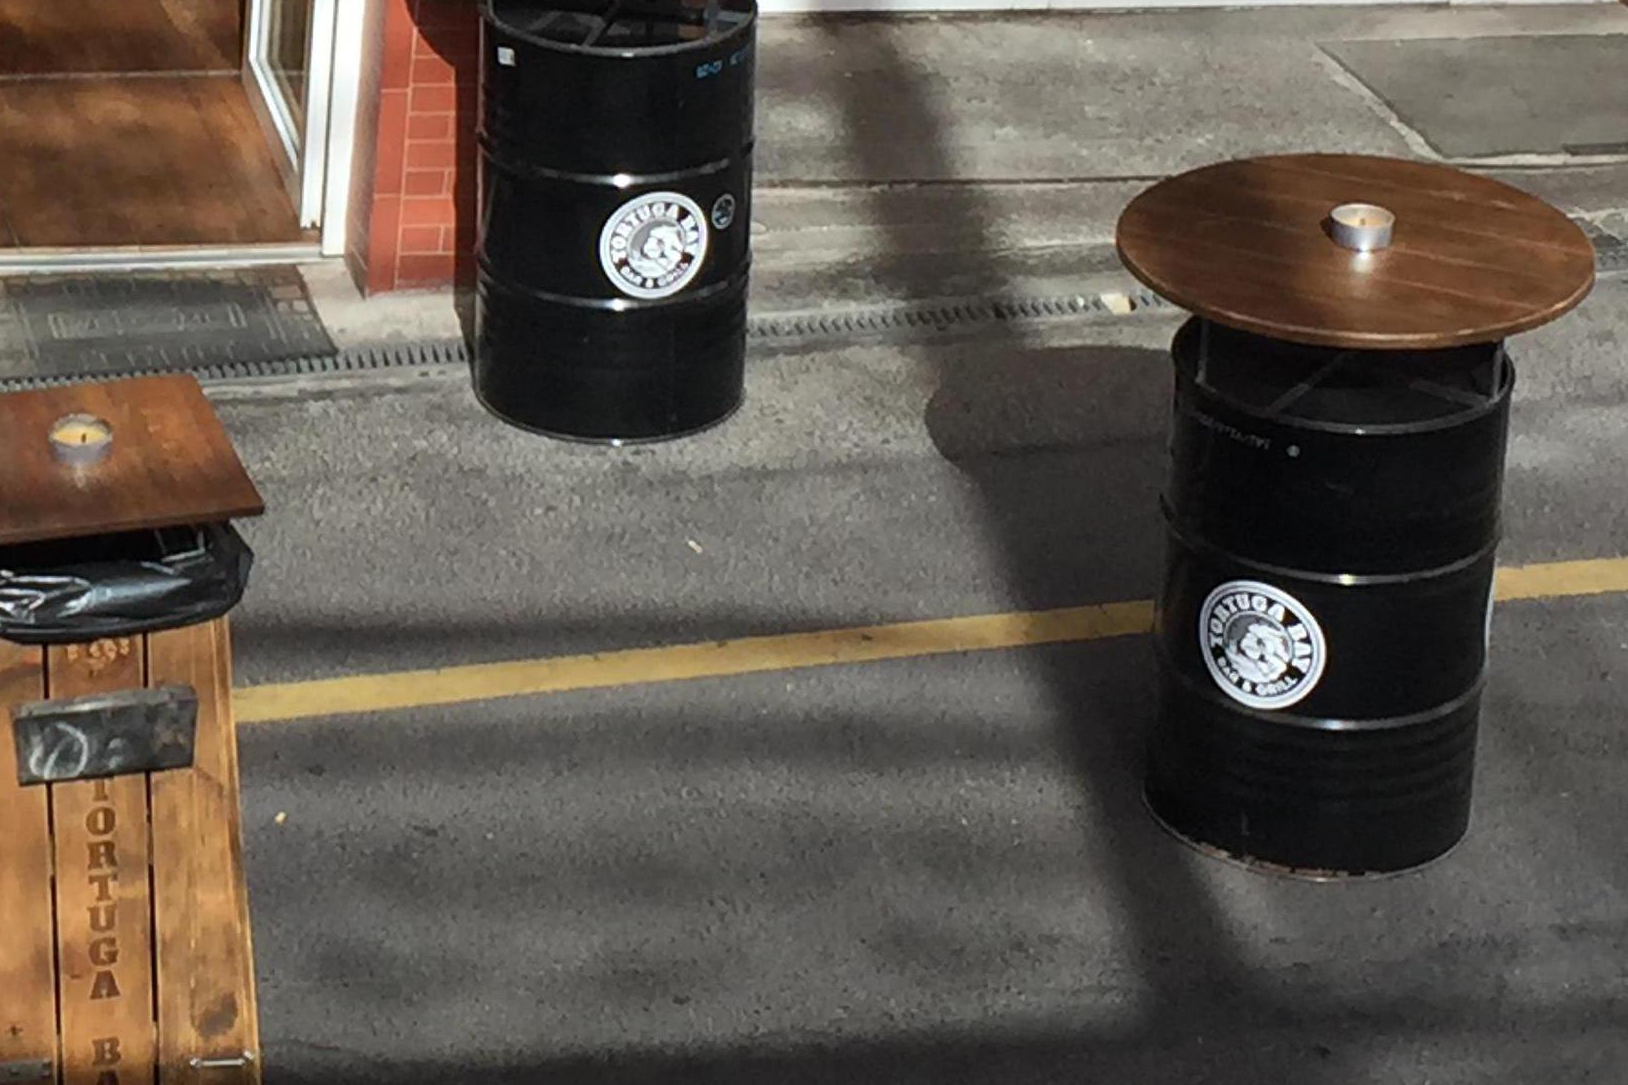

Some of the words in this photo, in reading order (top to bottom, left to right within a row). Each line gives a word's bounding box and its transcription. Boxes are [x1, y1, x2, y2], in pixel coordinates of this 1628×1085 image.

[611, 201, 680, 264] TORTUGA
[1209, 593, 1286, 648] TORTUGA
[1287, 622, 1312, 674] BAY
[84, 776, 122, 1000] TORTUGA
